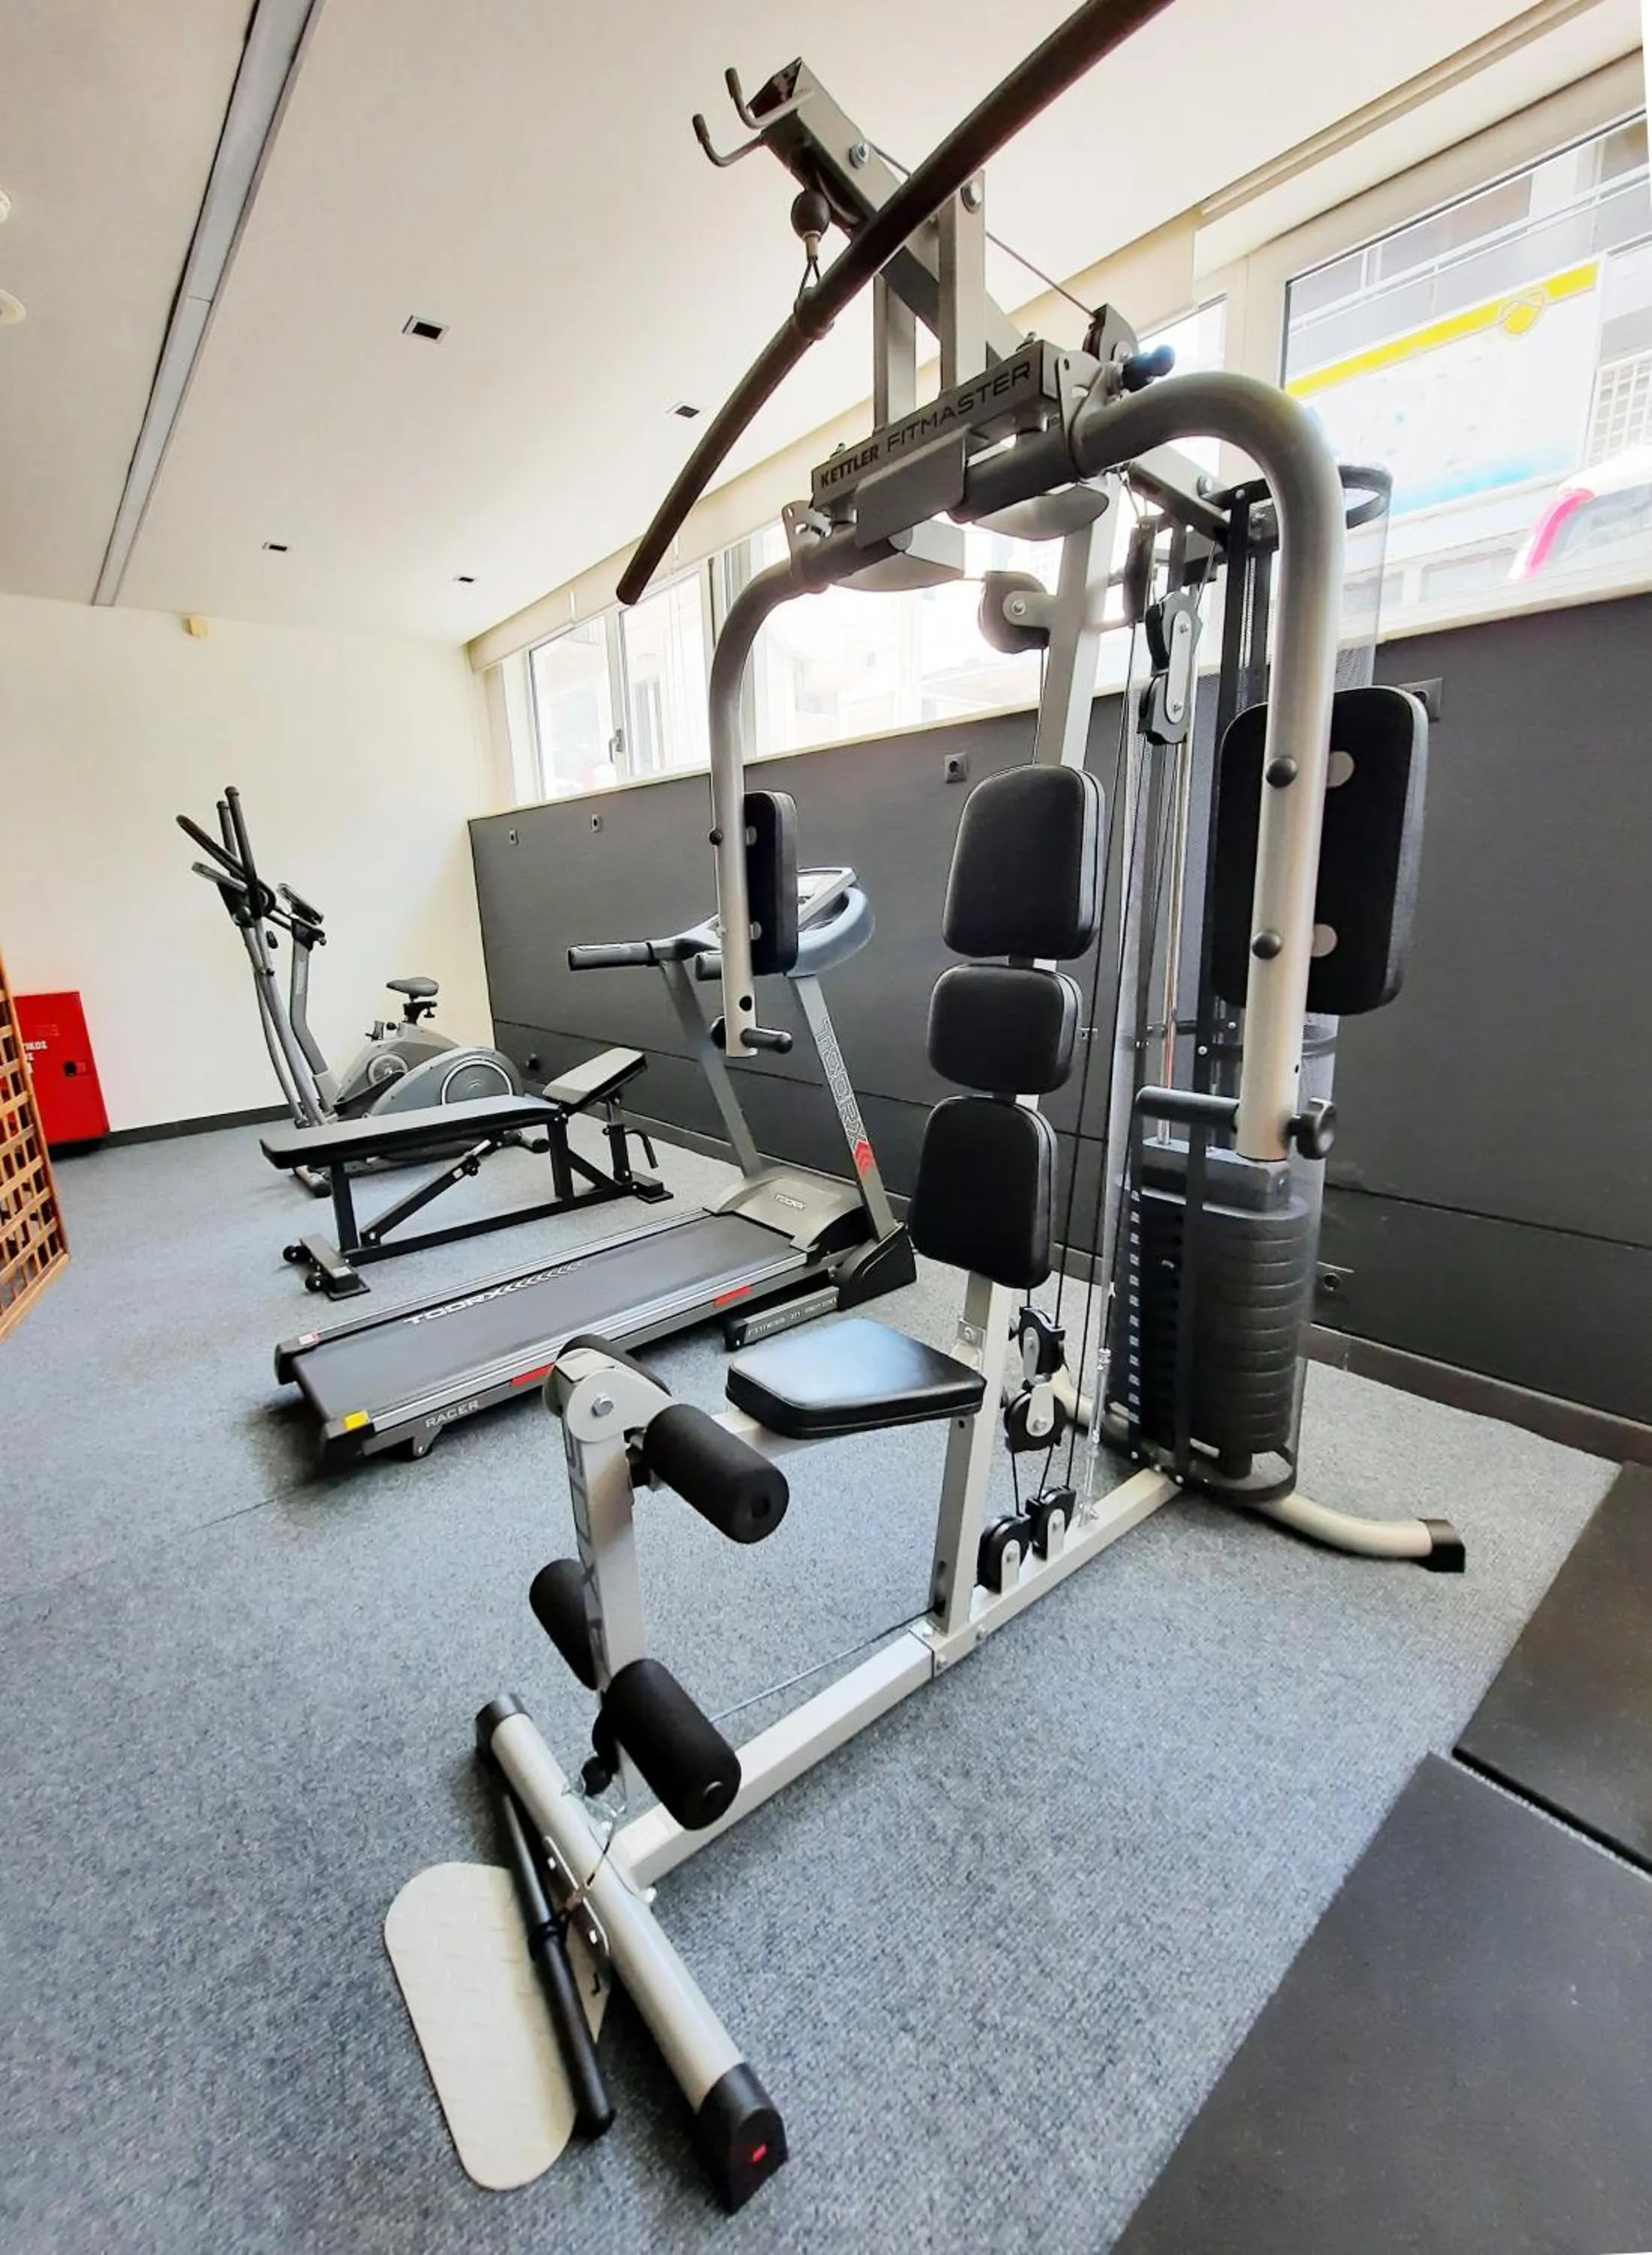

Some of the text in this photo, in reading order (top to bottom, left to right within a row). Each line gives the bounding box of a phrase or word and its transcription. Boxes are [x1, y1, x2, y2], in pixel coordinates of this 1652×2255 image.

[820, 361, 1031, 489] KETTLER FITMASTER
[404, 1289, 505, 1325] TOORX
[425, 1399, 480, 1428] RACER
